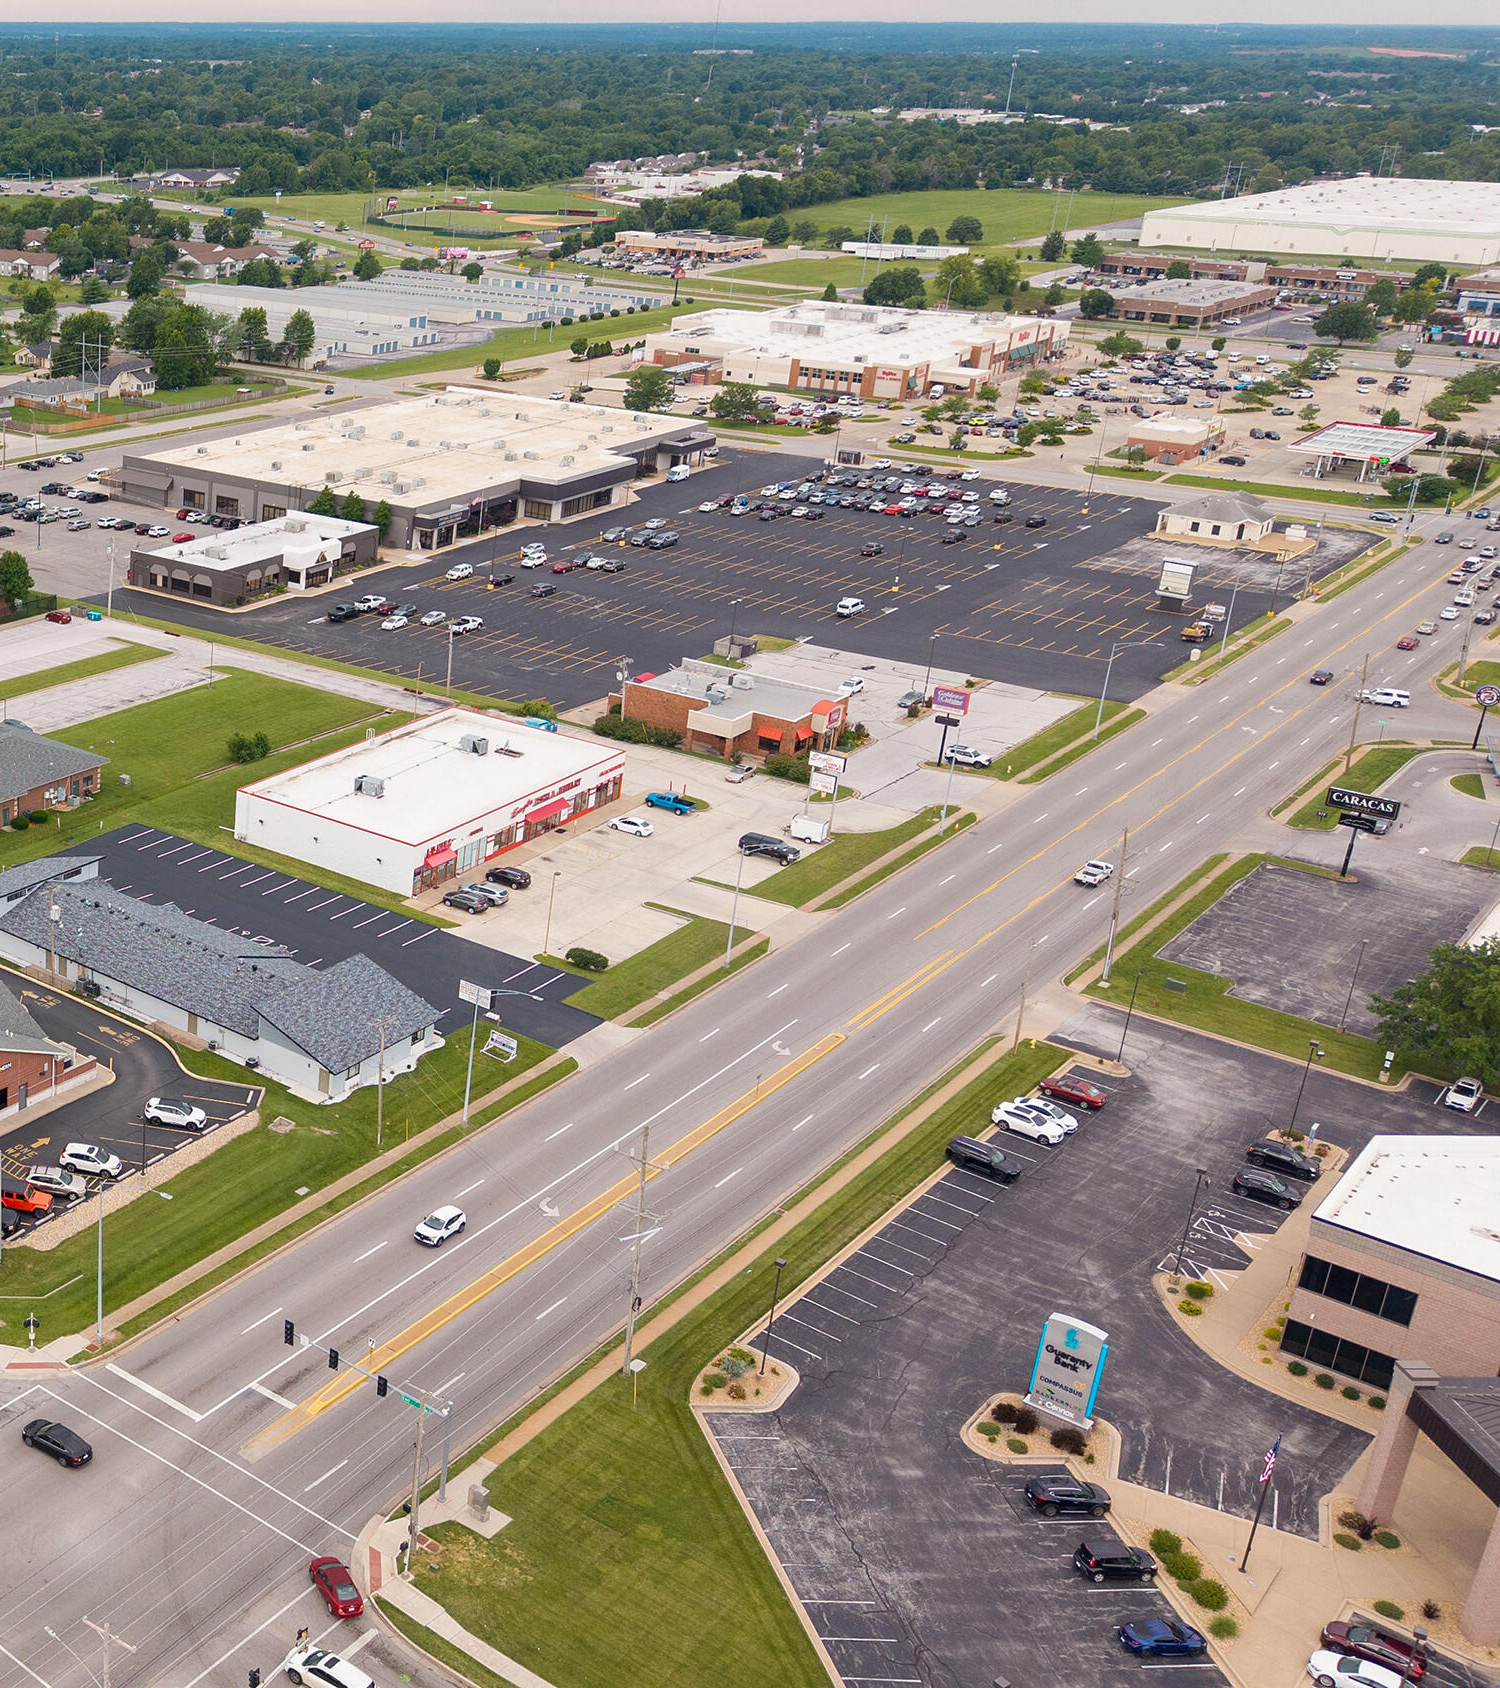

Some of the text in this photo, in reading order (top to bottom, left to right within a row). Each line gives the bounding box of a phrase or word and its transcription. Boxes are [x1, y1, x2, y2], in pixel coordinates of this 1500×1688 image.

[1332, 792, 1394, 813] CARACAS
[5, 1147, 29, 1161] WAY
[14, 1144, 38, 1158] ONE
[1045, 1344, 1093, 1370] Guaranty
[1054, 1356, 1079, 1373] Bank
[1040, 1375, 1083, 1398] COMPASSUS
